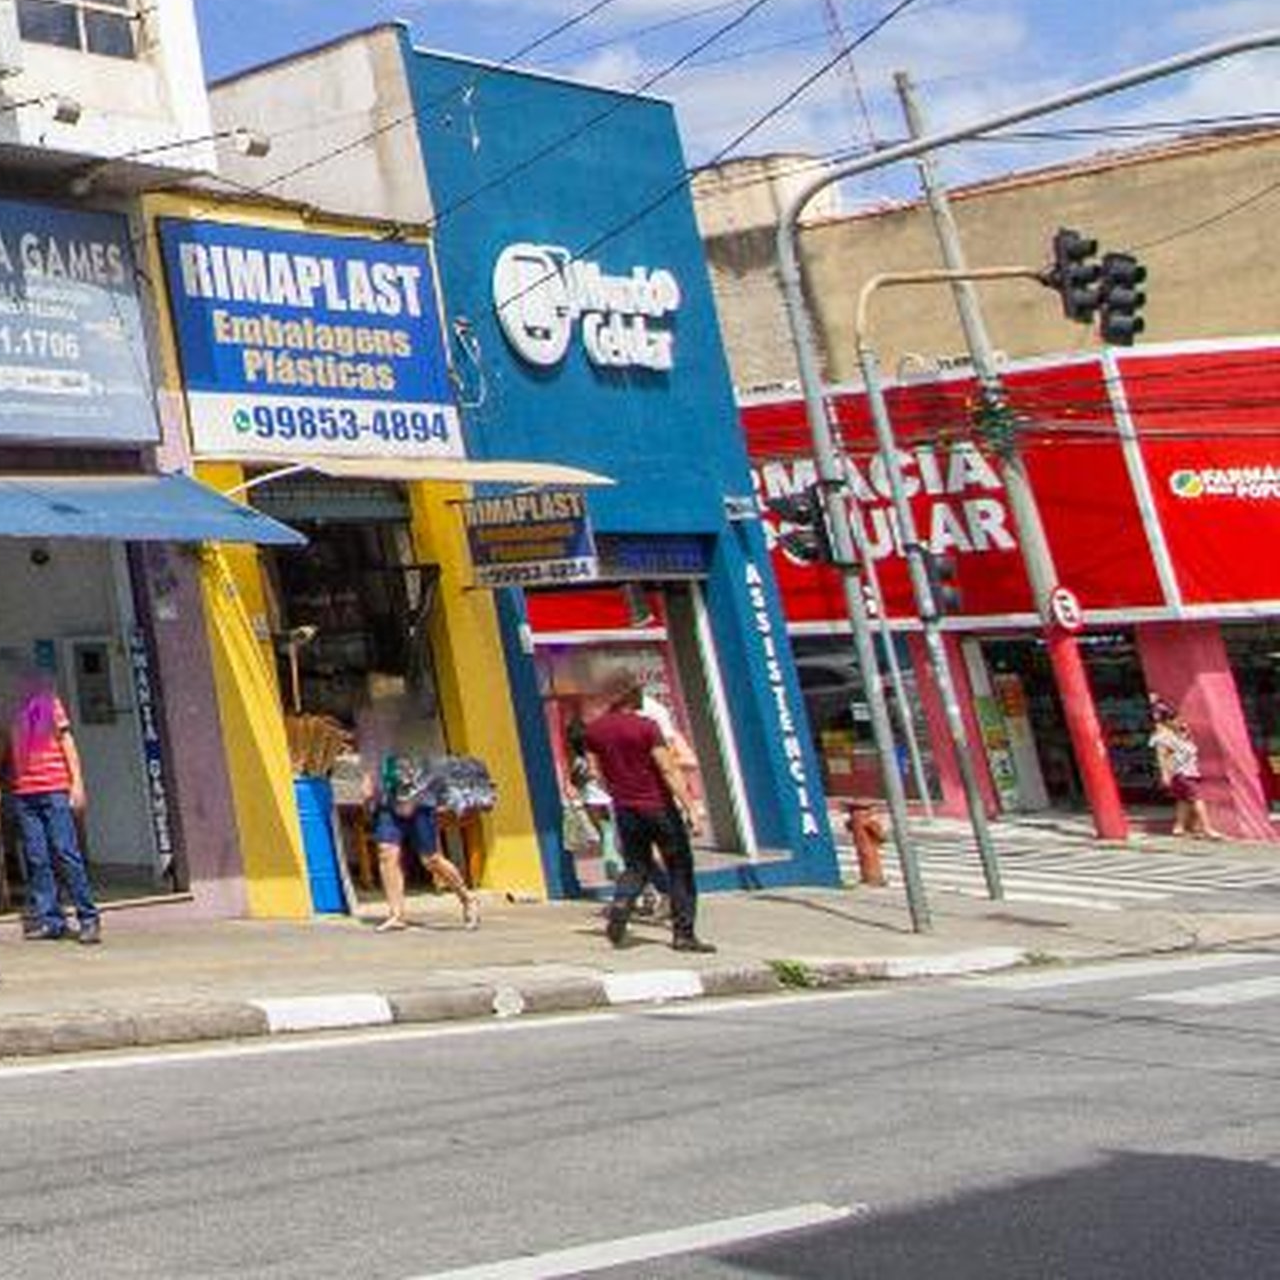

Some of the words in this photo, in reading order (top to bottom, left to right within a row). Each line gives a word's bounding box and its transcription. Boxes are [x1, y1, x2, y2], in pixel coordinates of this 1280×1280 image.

[20, 232, 125, 283] GAMES
[179, 242, 422, 318] RIMAPLAST
[212, 309, 412, 358] Embalagens
[243, 348, 396, 391] Plásticas
[252, 406, 449, 442] 99853-4894
[471, 492, 584, 527] RIMAPLAST
